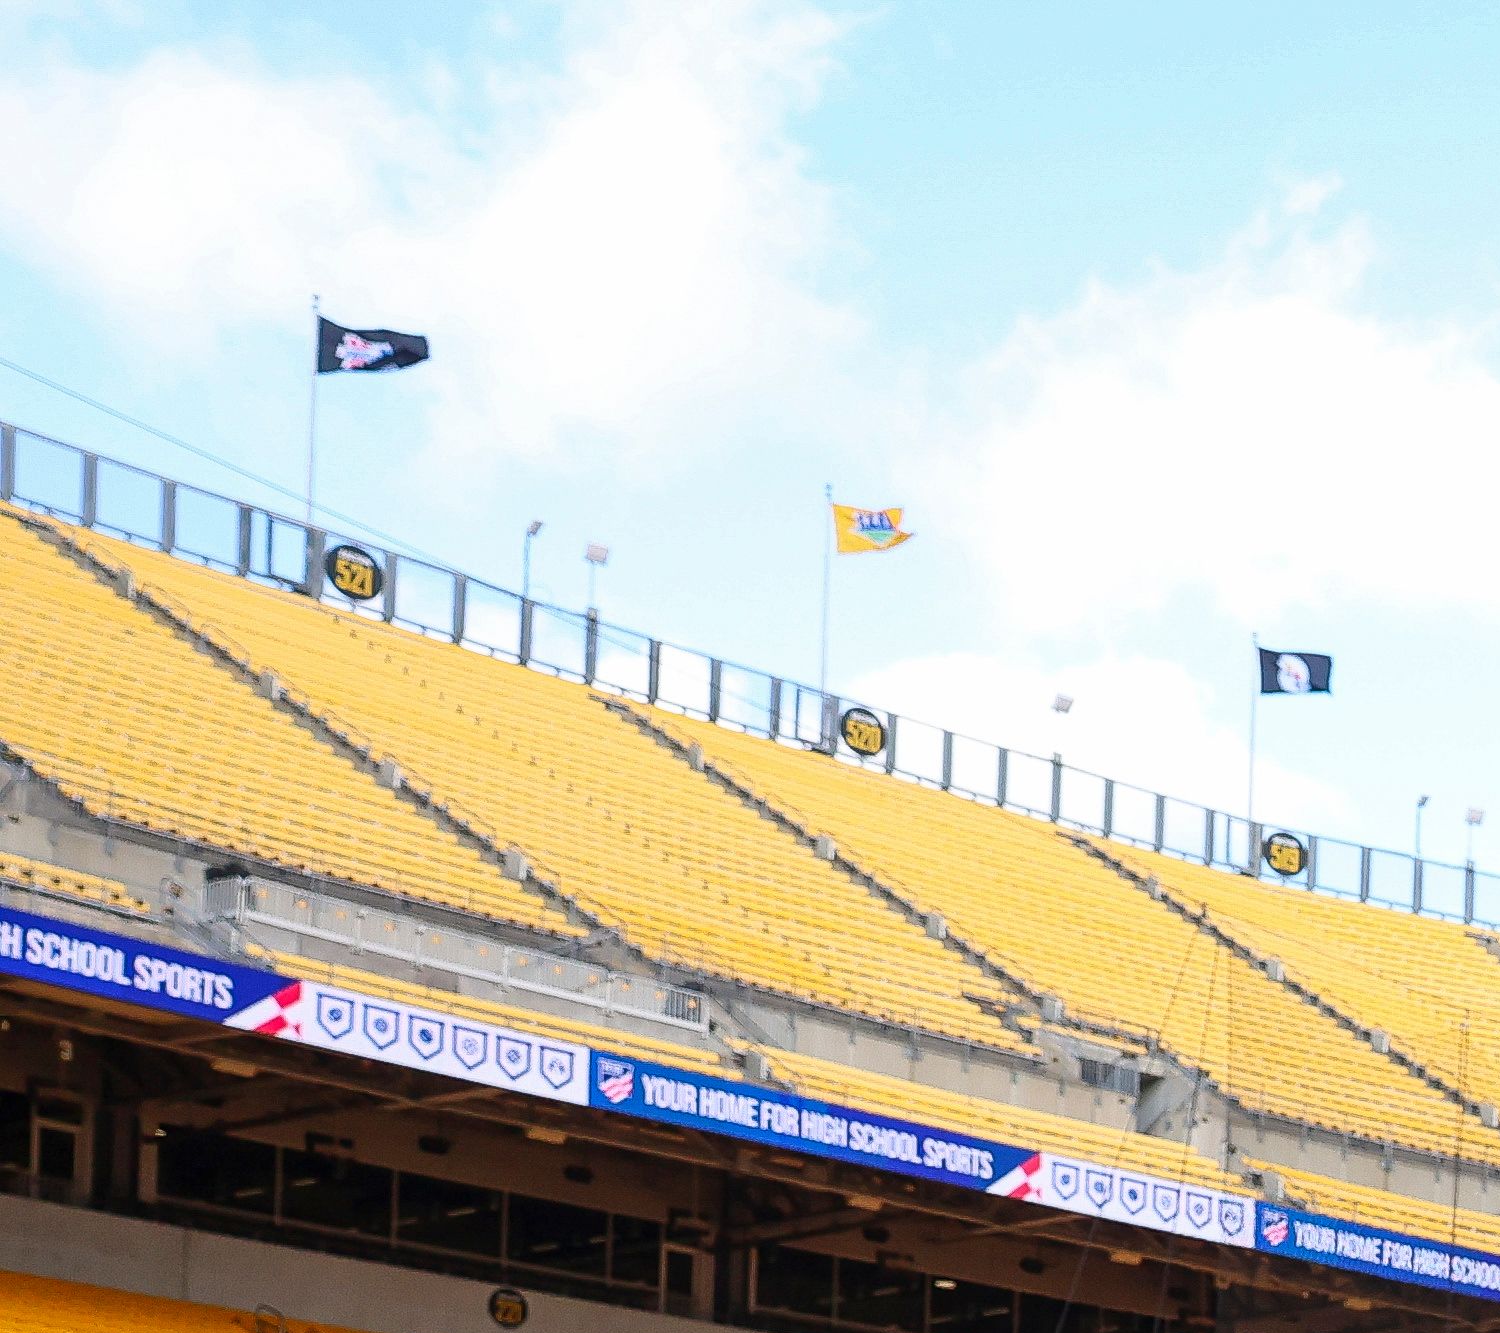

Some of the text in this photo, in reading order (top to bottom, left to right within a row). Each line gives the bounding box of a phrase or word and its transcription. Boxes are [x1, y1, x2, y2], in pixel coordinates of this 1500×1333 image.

[25, 928, 131, 986] SCHOOL
[133, 955, 234, 1009] SPORTS
[641, 1073, 994, 1179] YOUR HOME FOR HIGH SCHOOL SPORTS
[1294, 1220, 1336, 1253] YOUR
[1337, 1231, 1382, 1265] HOME
[1382, 1240, 1413, 1272] FOR
[1413, 1247, 1450, 1279] HIGH
